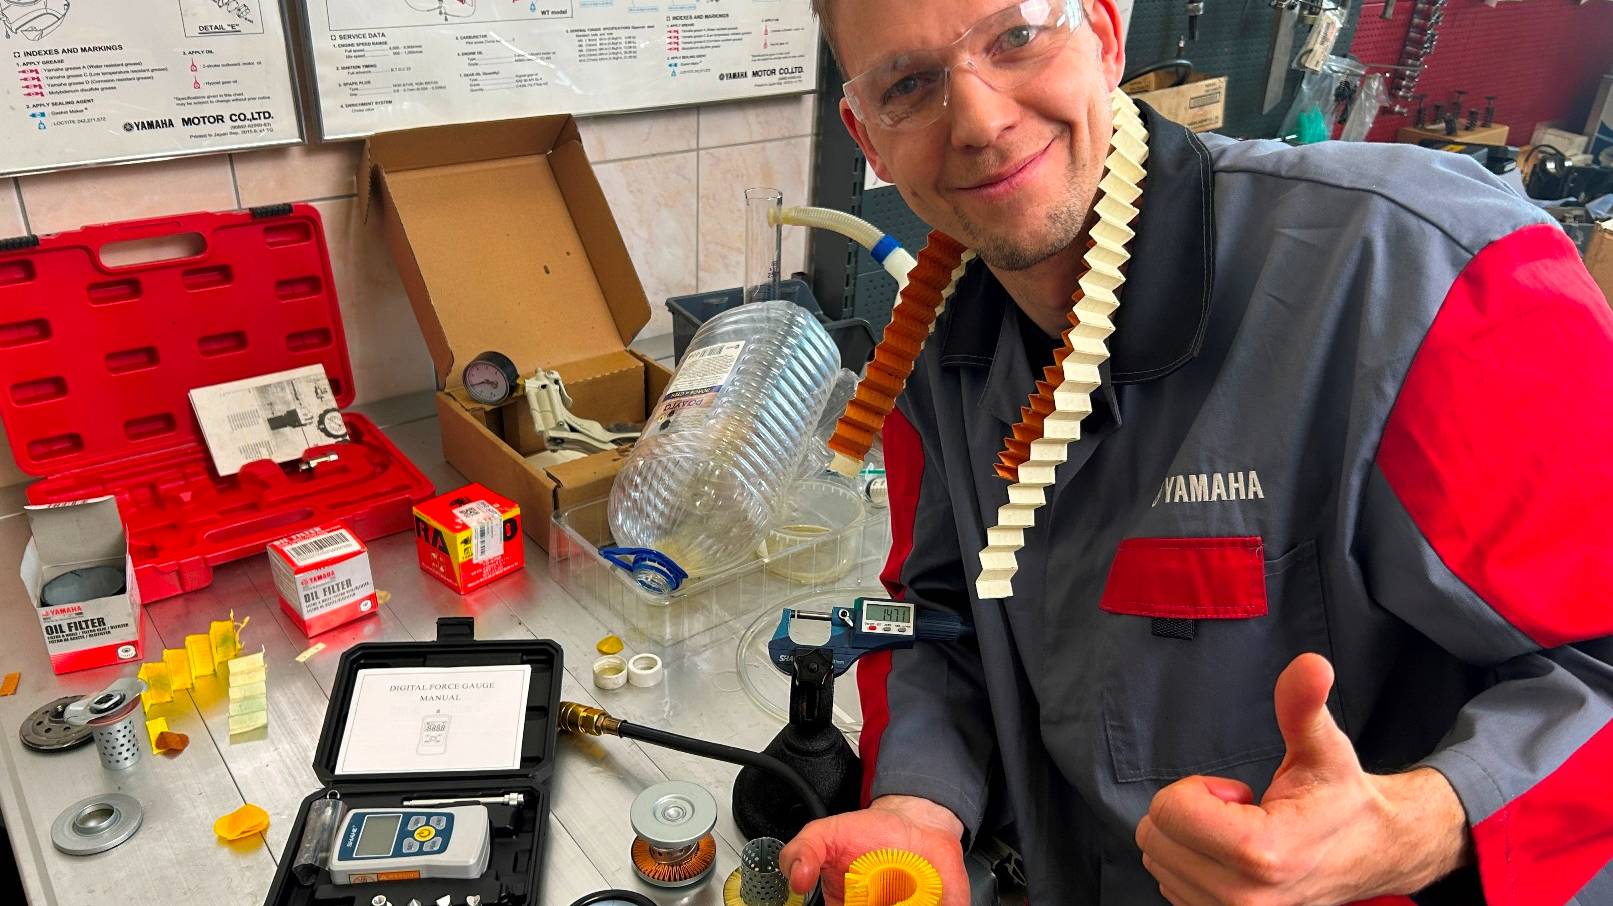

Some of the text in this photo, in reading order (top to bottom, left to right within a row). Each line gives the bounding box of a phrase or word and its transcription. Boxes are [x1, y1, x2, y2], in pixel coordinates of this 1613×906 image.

[198, 24, 226, 32] DETAIL
[24, 48, 60, 57] INDEXES
[752, 69, 776, 77] MOTOR
[134, 118, 174, 131] YAMAHA
[182, 114, 225, 127] MOTOR
[229, 110, 274, 123] CO.,LTD.
[1164, 470, 1264, 503] YAMAHA
[310, 569, 336, 584] YAMAHA
[304, 578, 352, 603] OIL FILTER
[50, 605, 82, 616] YAMAHA
[45, 623, 66, 635] OIL
[67, 617, 106, 632] FILTER
[390, 682, 495, 692] DIGITAL FORCE GAUGE
